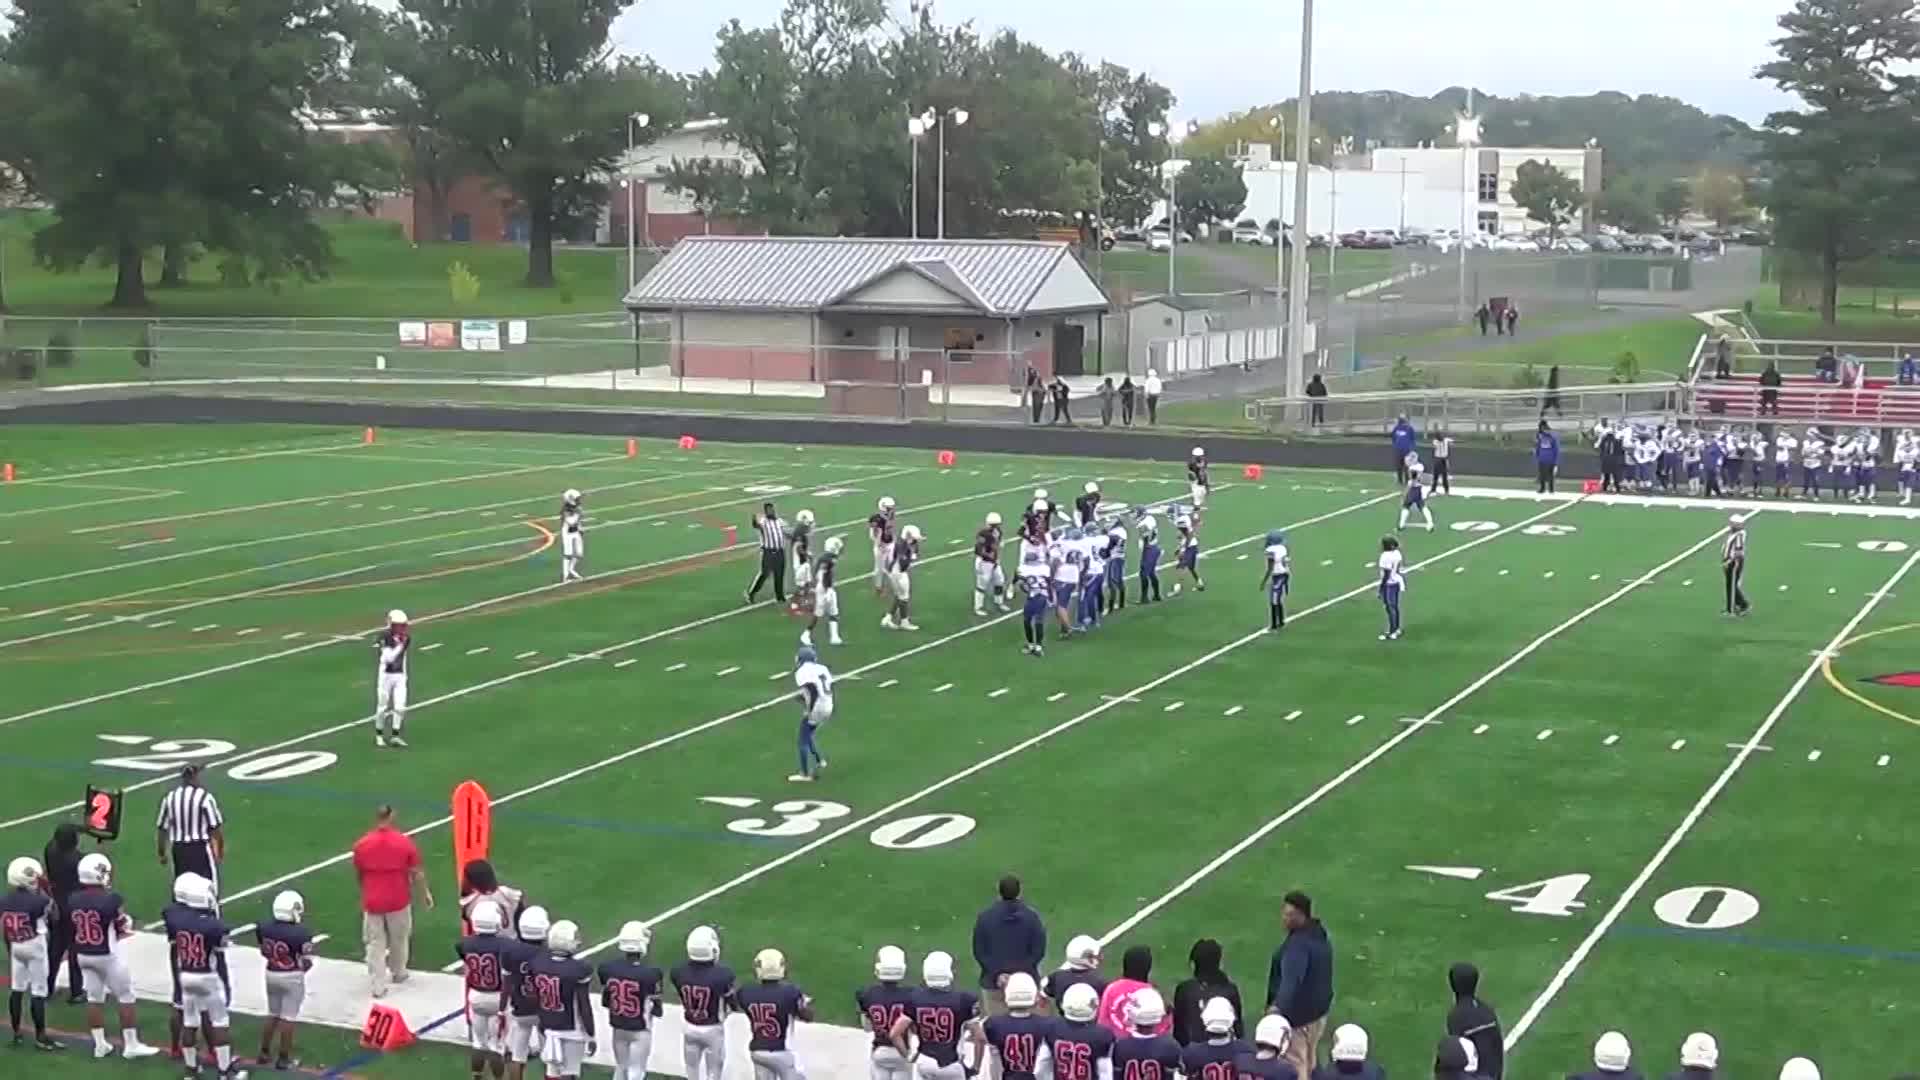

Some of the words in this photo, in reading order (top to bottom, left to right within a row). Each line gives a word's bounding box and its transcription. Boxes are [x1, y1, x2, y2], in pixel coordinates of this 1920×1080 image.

[91, 792, 111, 830] 2
[681, 984, 711, 1020] 17
[748, 1002, 782, 1039] 15
[916, 1007, 955, 1043] 59
[1003, 1033, 1034, 1073] 41
[1053, 1039, 1092, 1080] 56
